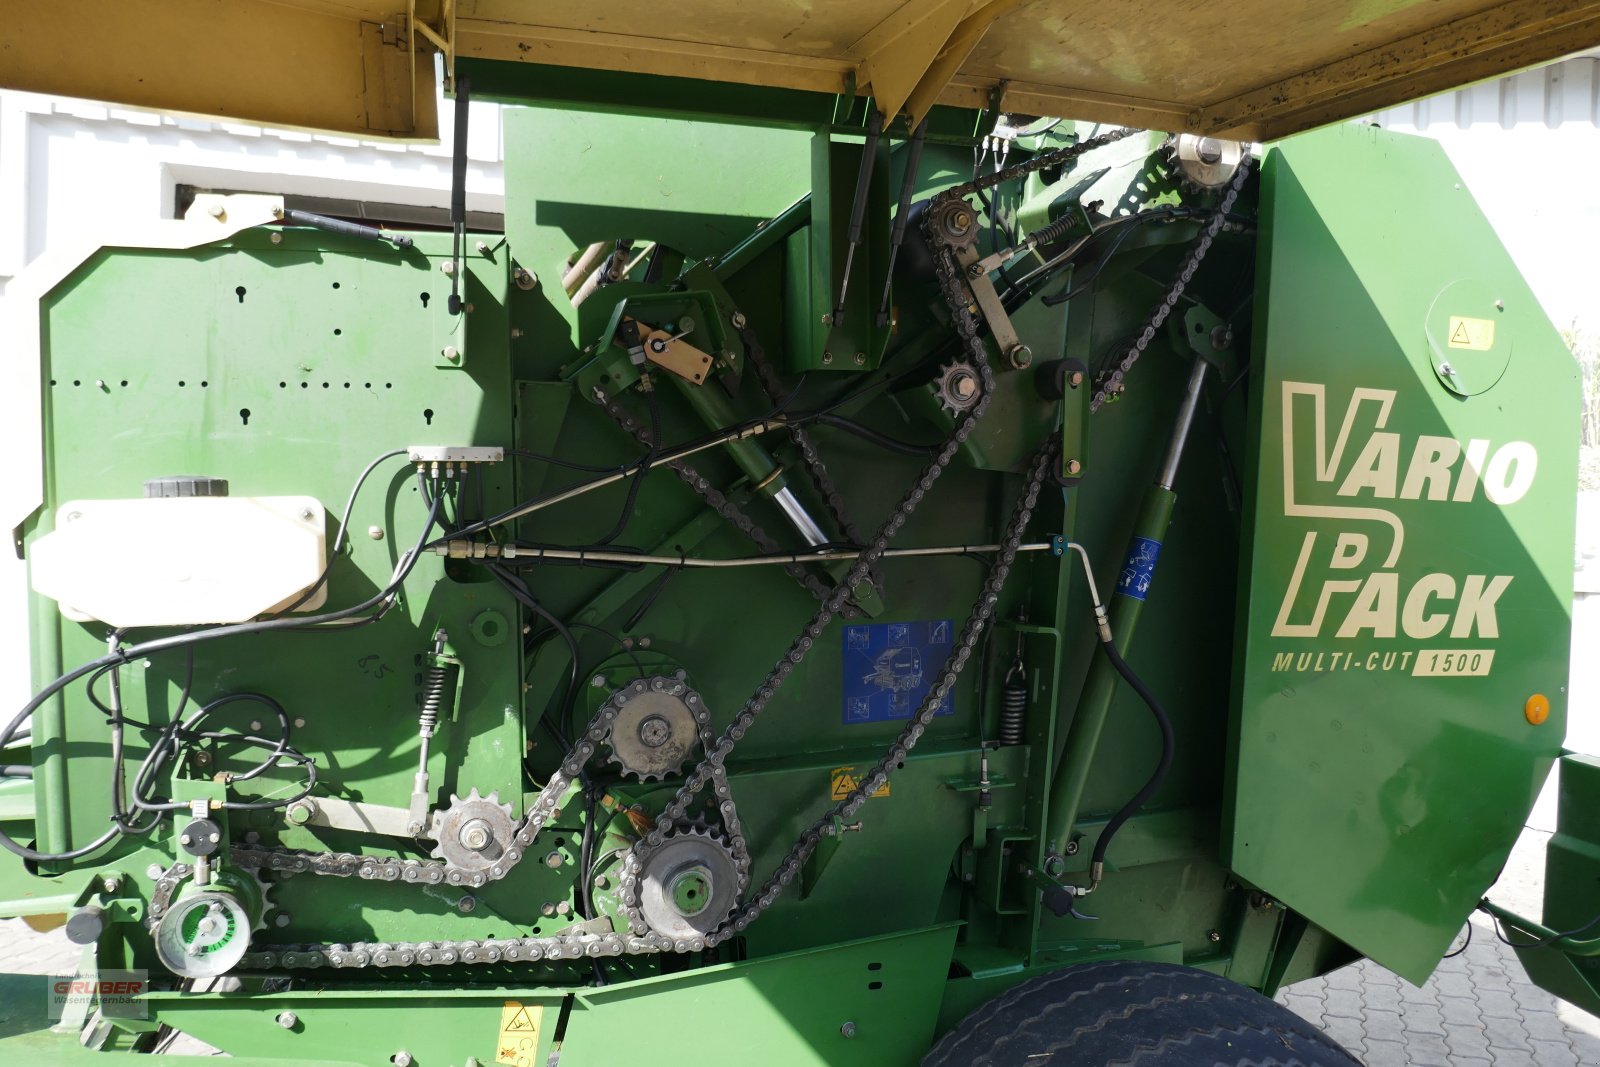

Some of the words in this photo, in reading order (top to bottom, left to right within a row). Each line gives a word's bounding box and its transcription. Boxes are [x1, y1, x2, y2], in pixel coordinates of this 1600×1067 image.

[1282, 381, 1538, 506] VARIO
[1271, 506, 1514, 640] PACK
[1271, 652, 1413, 672] MULTI-CUT
[1430, 653, 1482, 673] 1500
